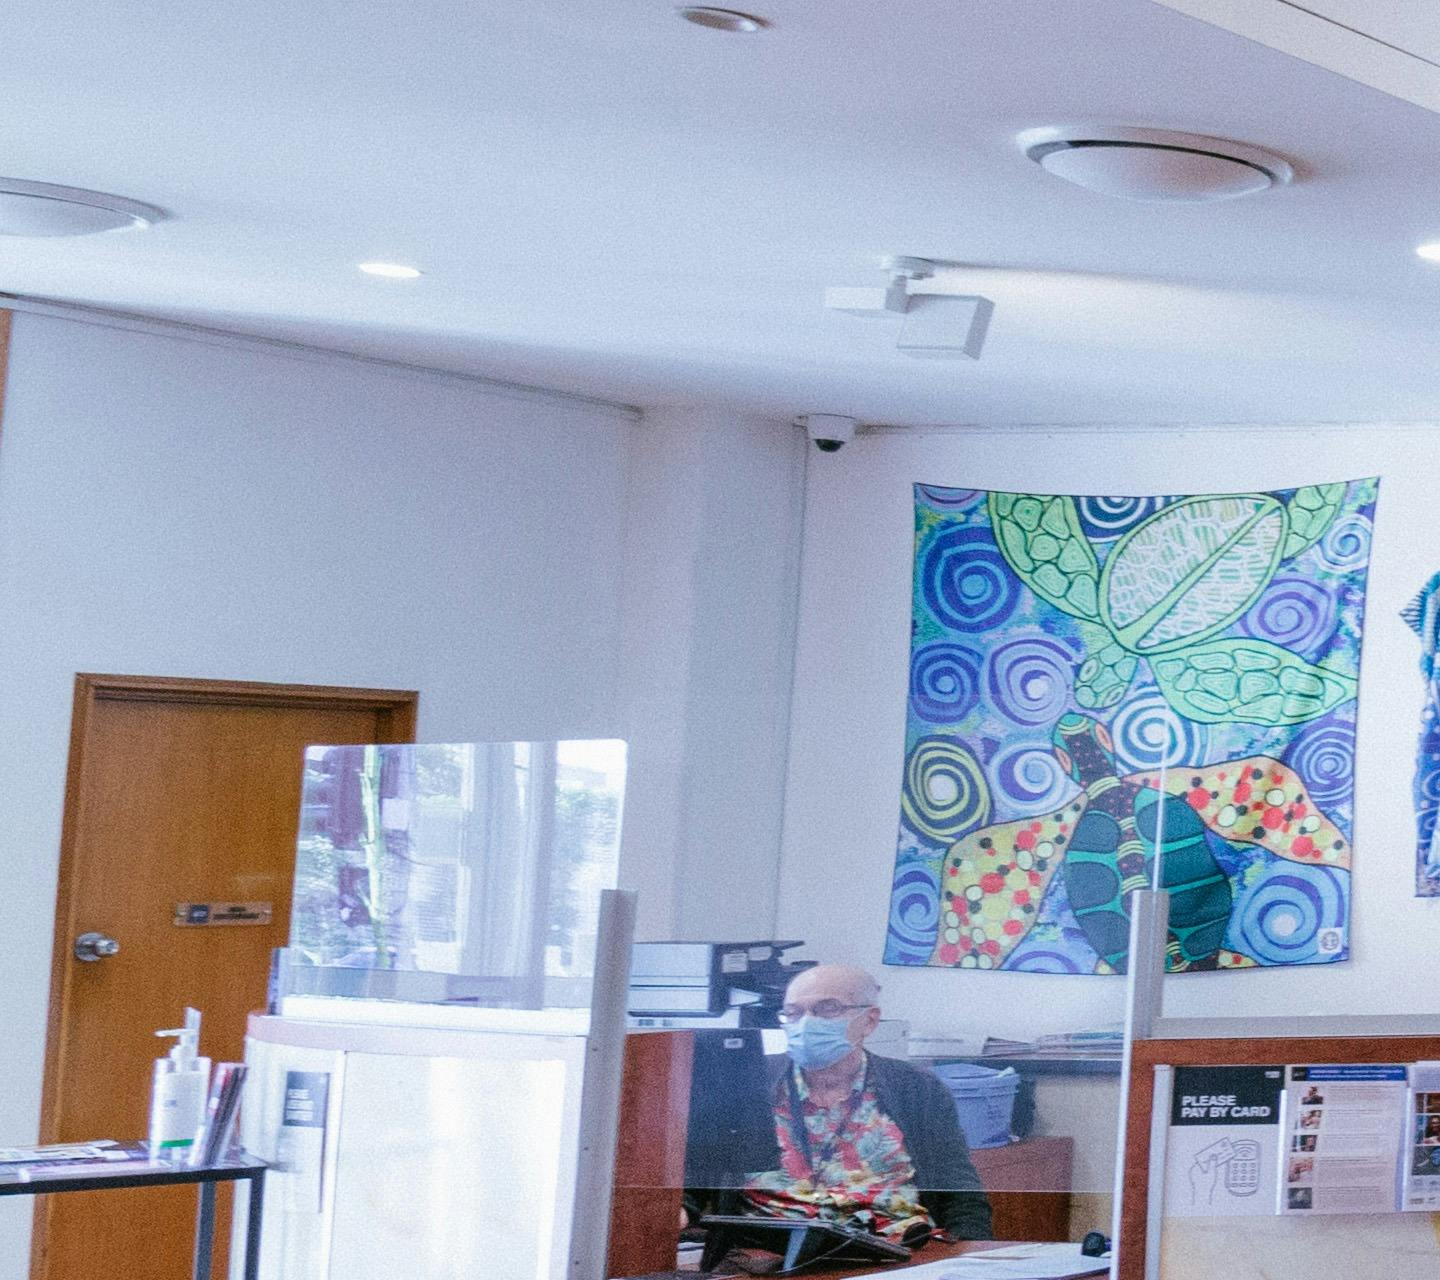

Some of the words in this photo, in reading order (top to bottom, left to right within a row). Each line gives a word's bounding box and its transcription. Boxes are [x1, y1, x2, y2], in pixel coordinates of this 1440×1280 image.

[1182, 1095, 1237, 1106] PLEASE
[1181, 1107, 1207, 1118] PAY
[1209, 1107, 1228, 1117] BY
[1230, 1106, 1271, 1117] CARD
